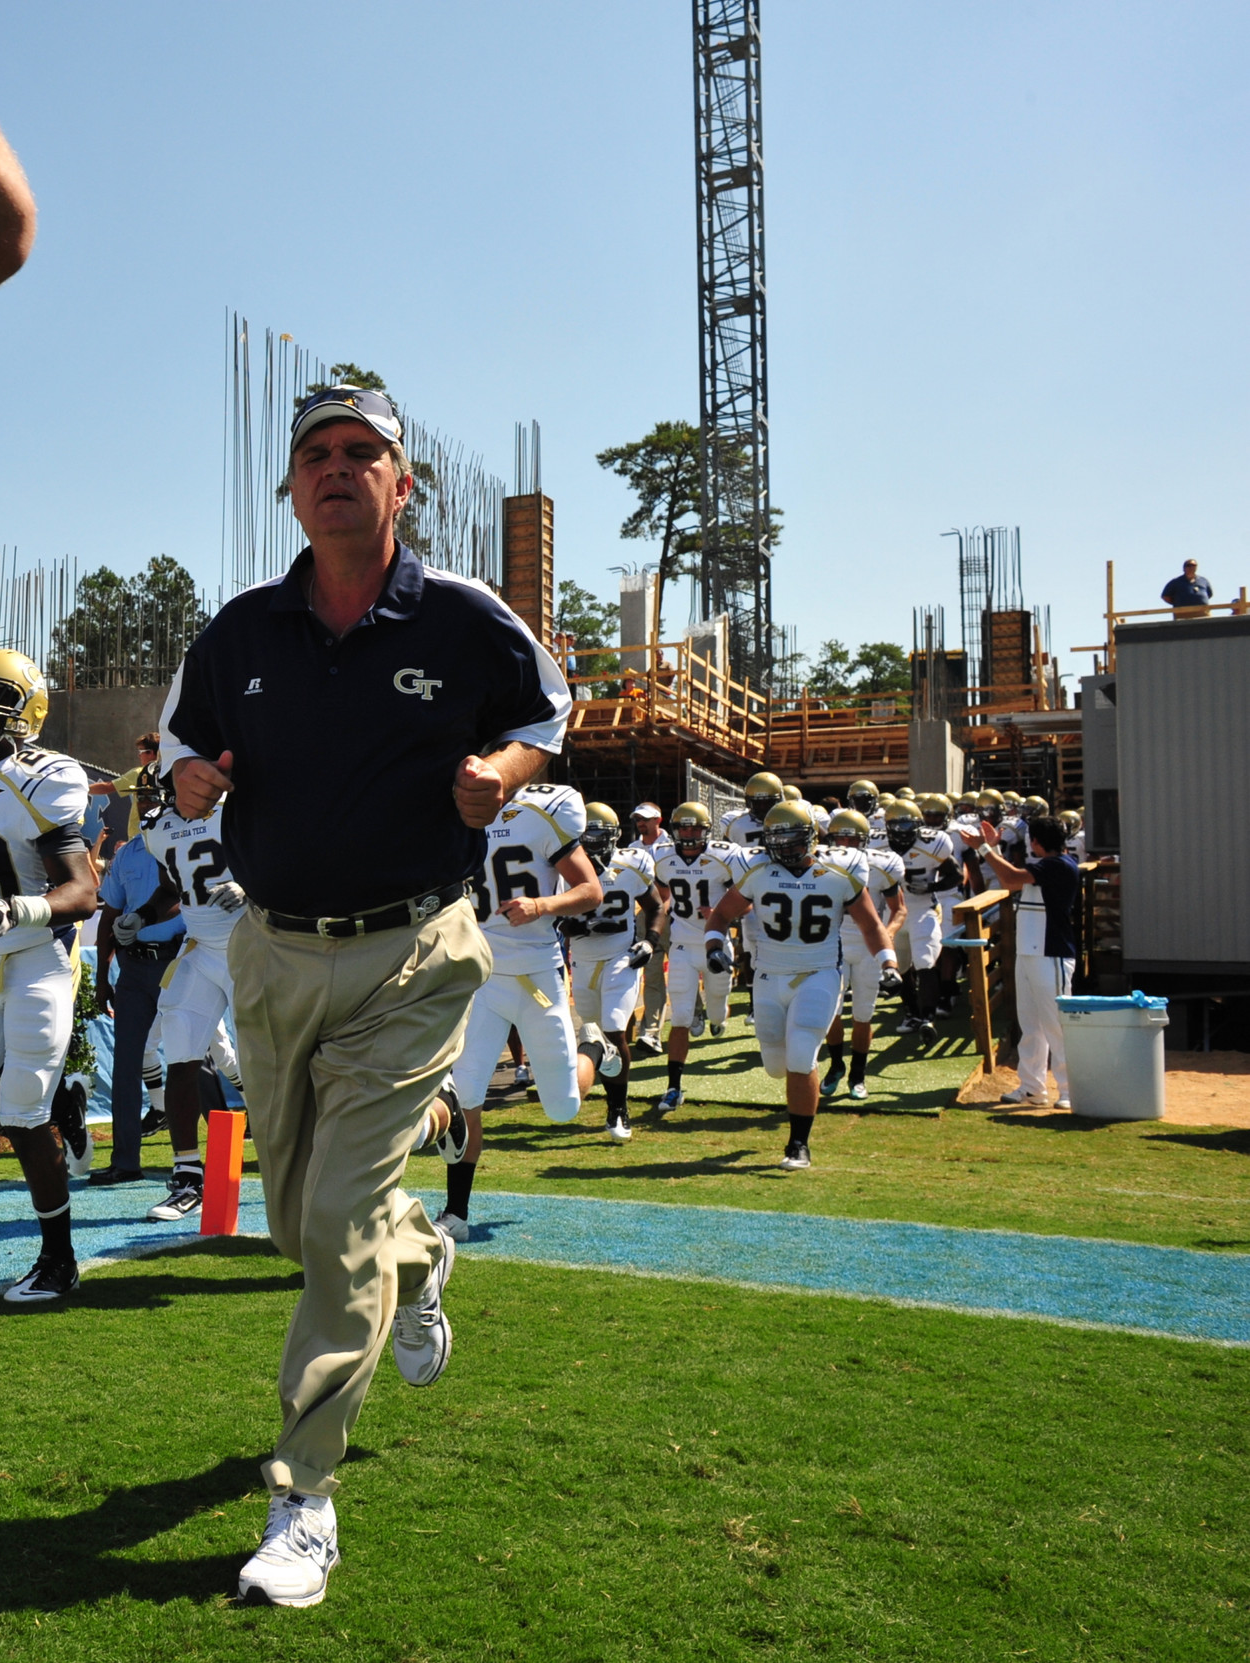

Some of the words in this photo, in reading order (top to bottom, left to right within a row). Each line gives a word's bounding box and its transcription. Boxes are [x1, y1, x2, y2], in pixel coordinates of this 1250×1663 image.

[393, 668, 443, 701] GT
[192, 826, 207, 836] TECH
[492, 829, 511, 839] TECH
[164, 837, 230, 908] 12
[778, 882, 801, 891] GEORGIA
[802, 883, 817, 891] TECH
[668, 878, 710, 920] 81
[760, 891, 834, 945] 36
